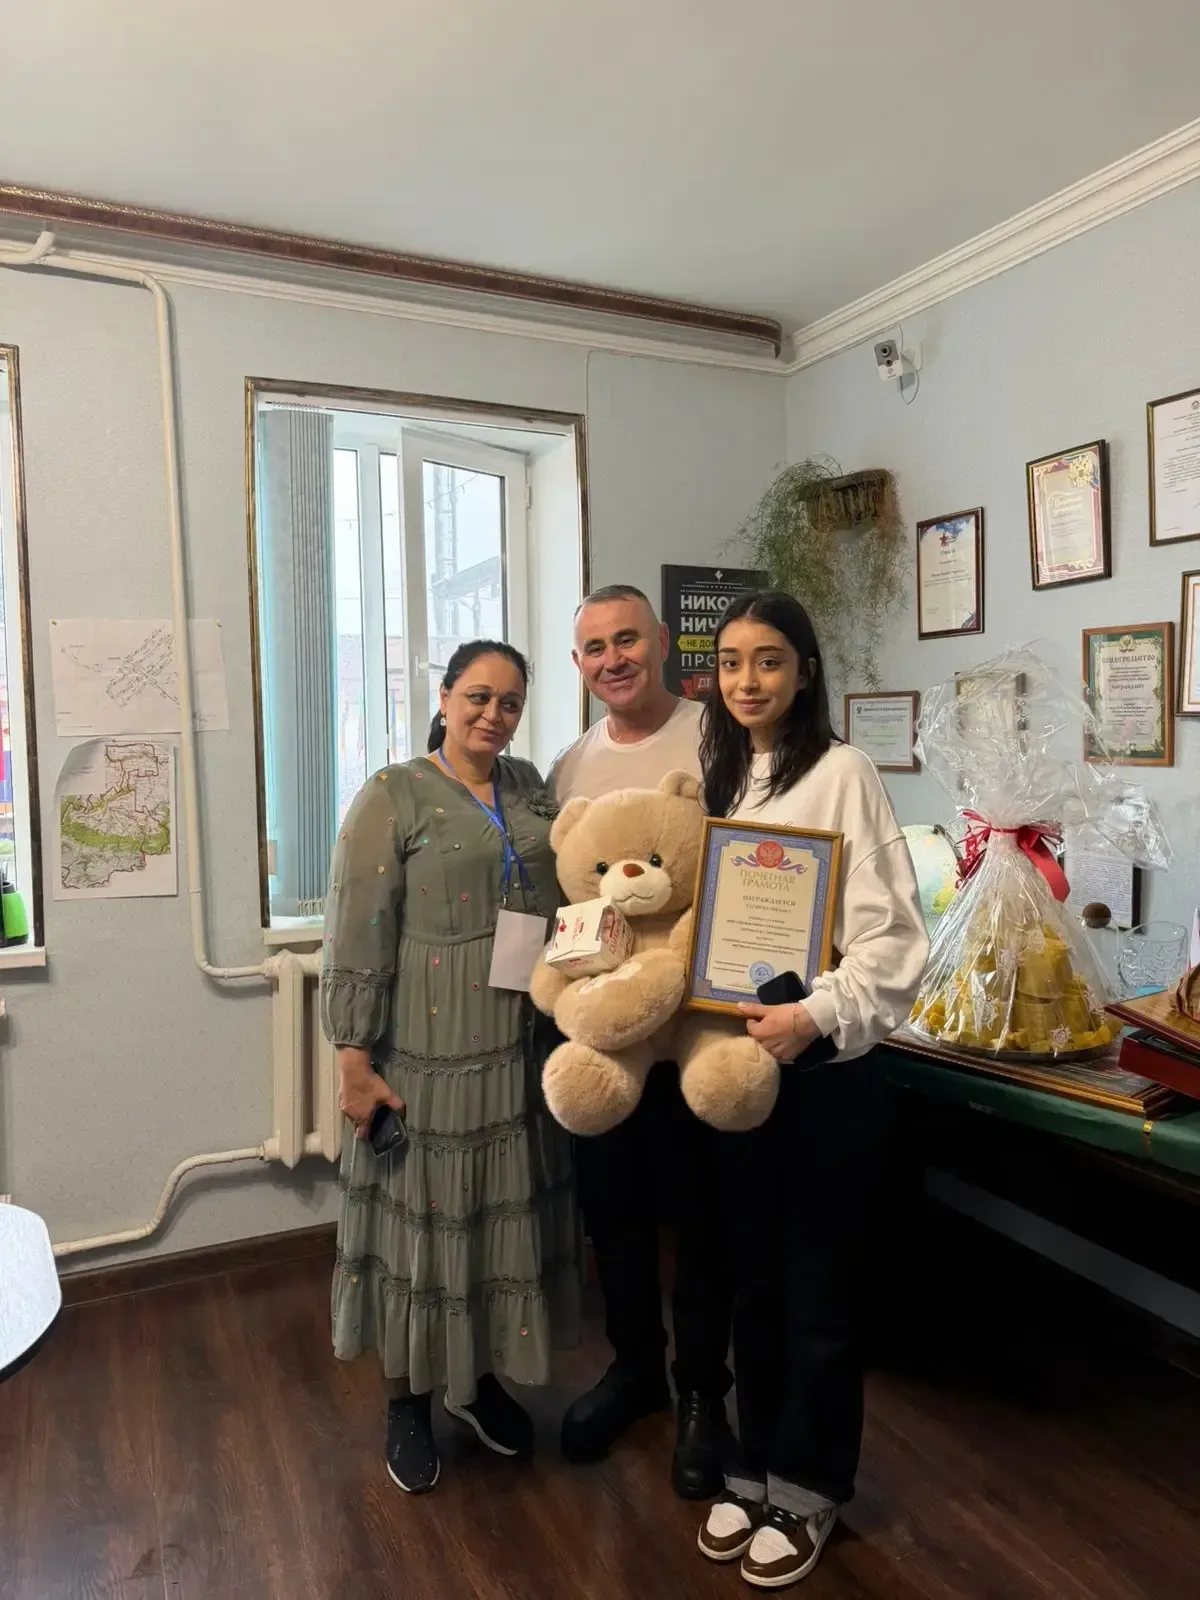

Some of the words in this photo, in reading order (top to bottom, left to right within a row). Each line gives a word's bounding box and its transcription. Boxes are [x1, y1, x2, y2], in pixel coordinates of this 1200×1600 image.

[681, 595, 735, 611] НИКО
[699, 640, 713, 649] ДО
[740, 869, 796, 884] ПОЧЕТНАЯ
[742, 878, 790, 892] ГРАМОТА
